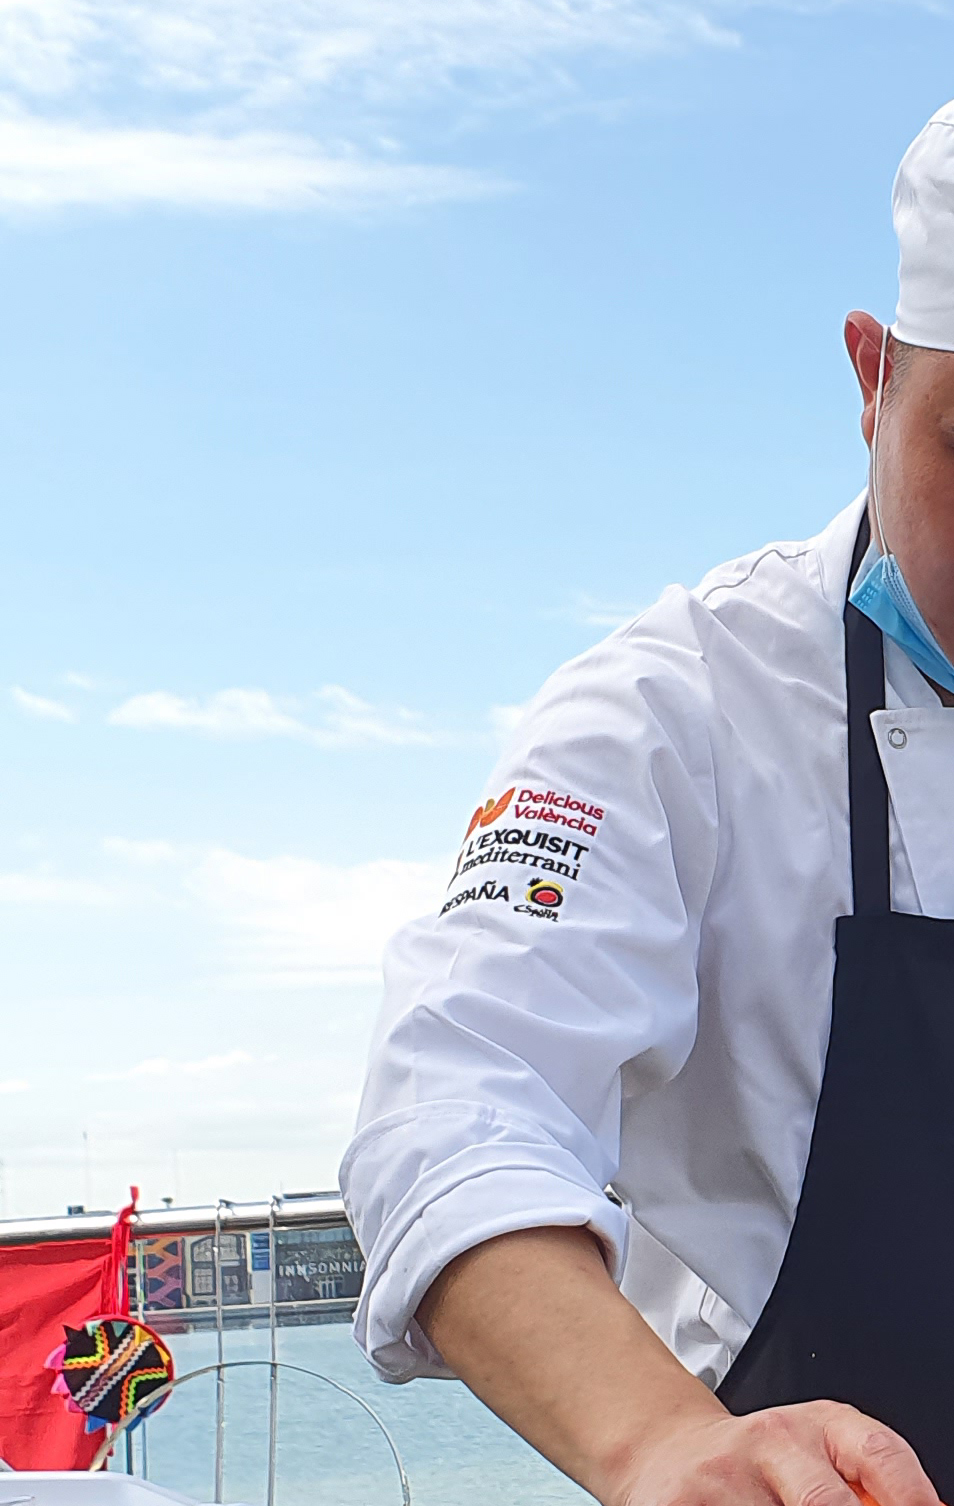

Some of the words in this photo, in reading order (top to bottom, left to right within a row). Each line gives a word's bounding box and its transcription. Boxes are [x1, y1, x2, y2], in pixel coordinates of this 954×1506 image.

[514, 804, 597, 836] València
[517, 789, 605, 820] Delicious
[466, 828, 589, 861] L'EXQUISIT
[459, 846, 581, 882] mediterrani
